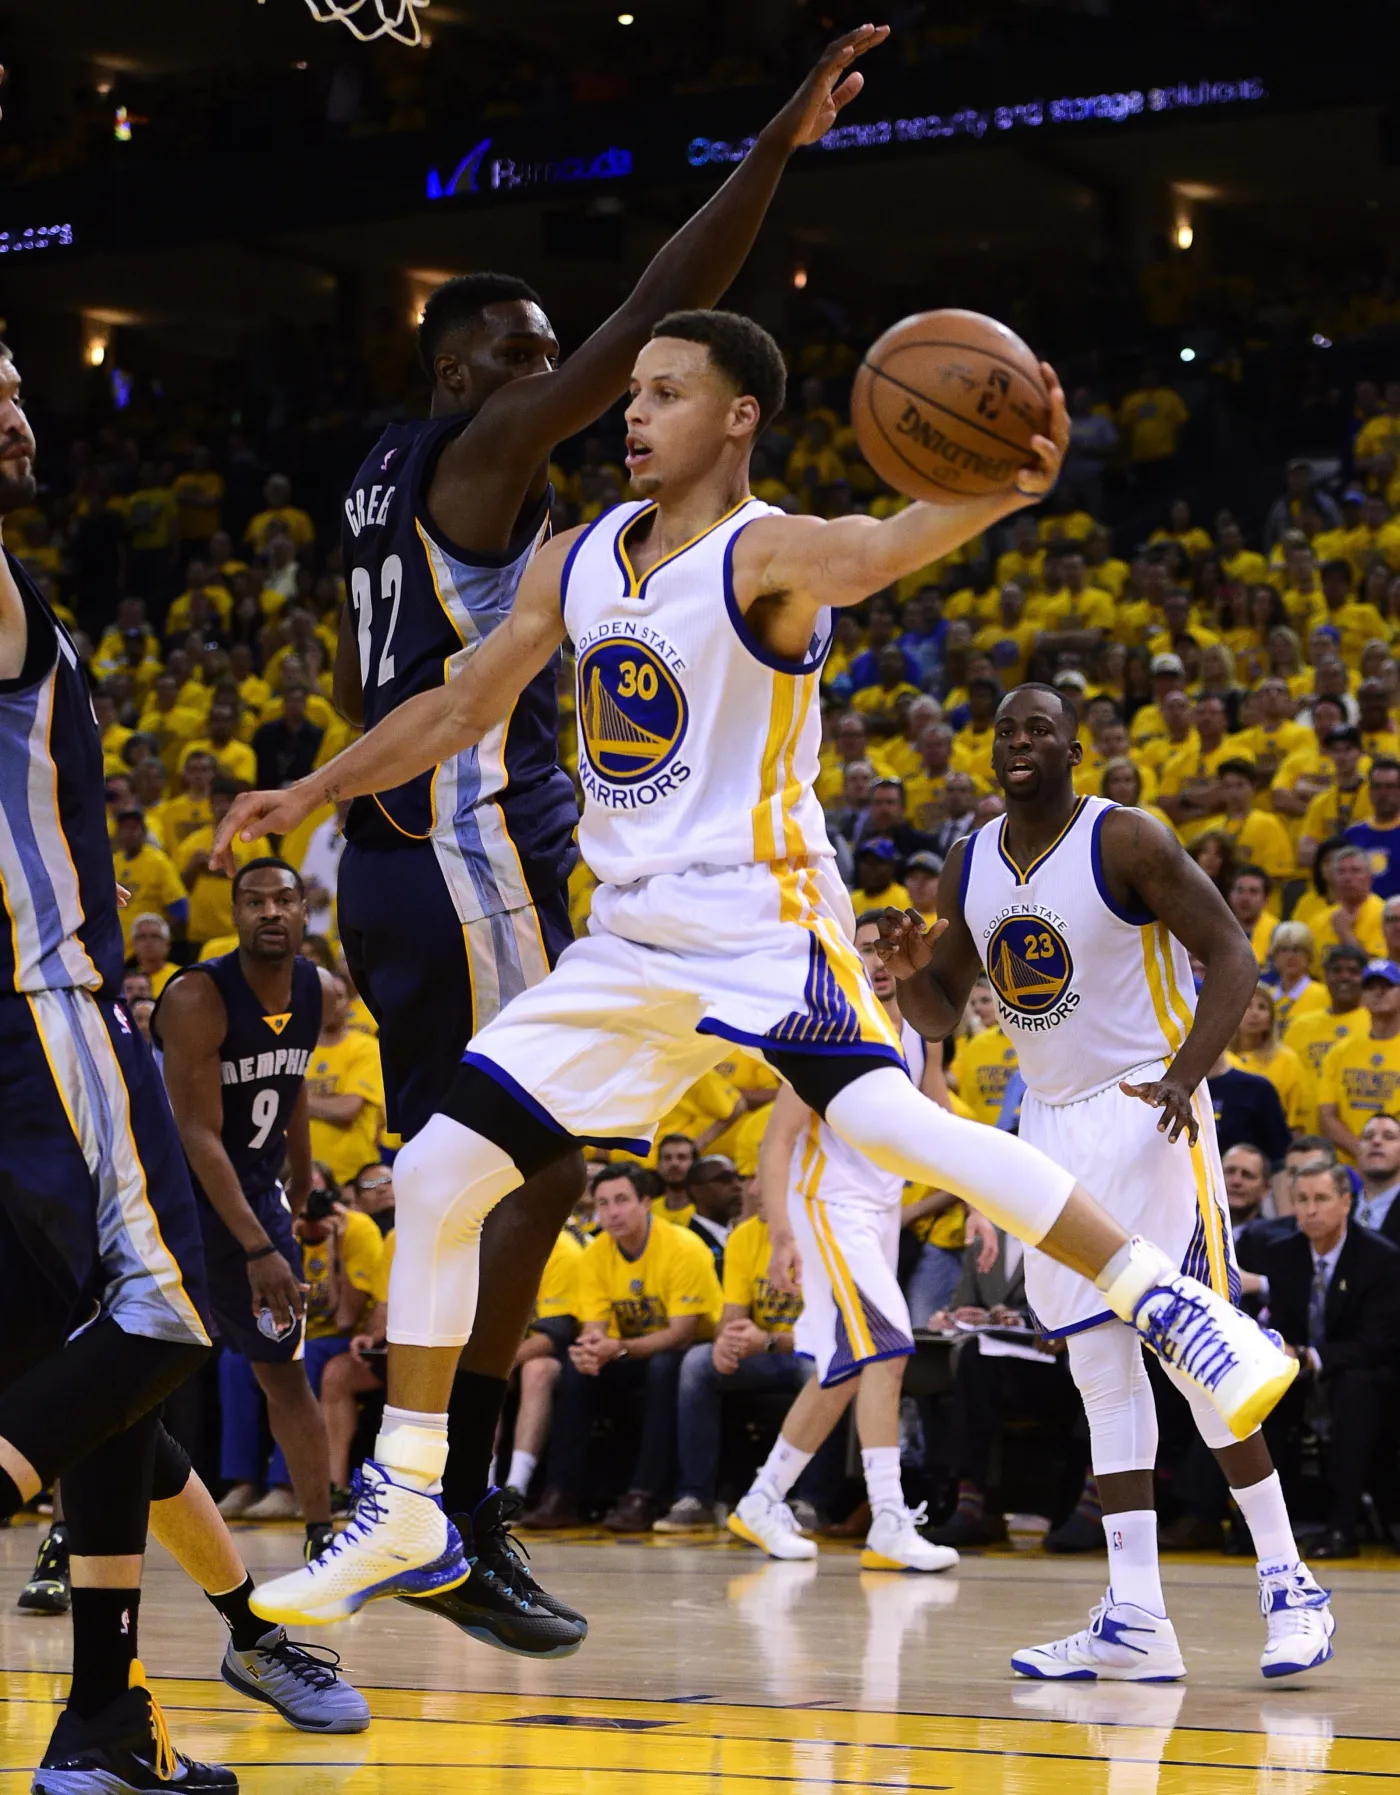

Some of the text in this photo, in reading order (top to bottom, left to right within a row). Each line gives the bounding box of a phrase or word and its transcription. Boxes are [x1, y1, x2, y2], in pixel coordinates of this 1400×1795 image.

[345, 484, 396, 538] GREE
[641, 627, 687, 675] STATE
[617, 660, 659, 701] 30
[579, 752, 691, 810] WARRIORS
[983, 904, 1068, 939] GOLDEN STATE
[1023, 932, 1055, 960] 23
[998, 991, 1081, 1032] WARRIORS
[248, 1088, 280, 1149] 9
